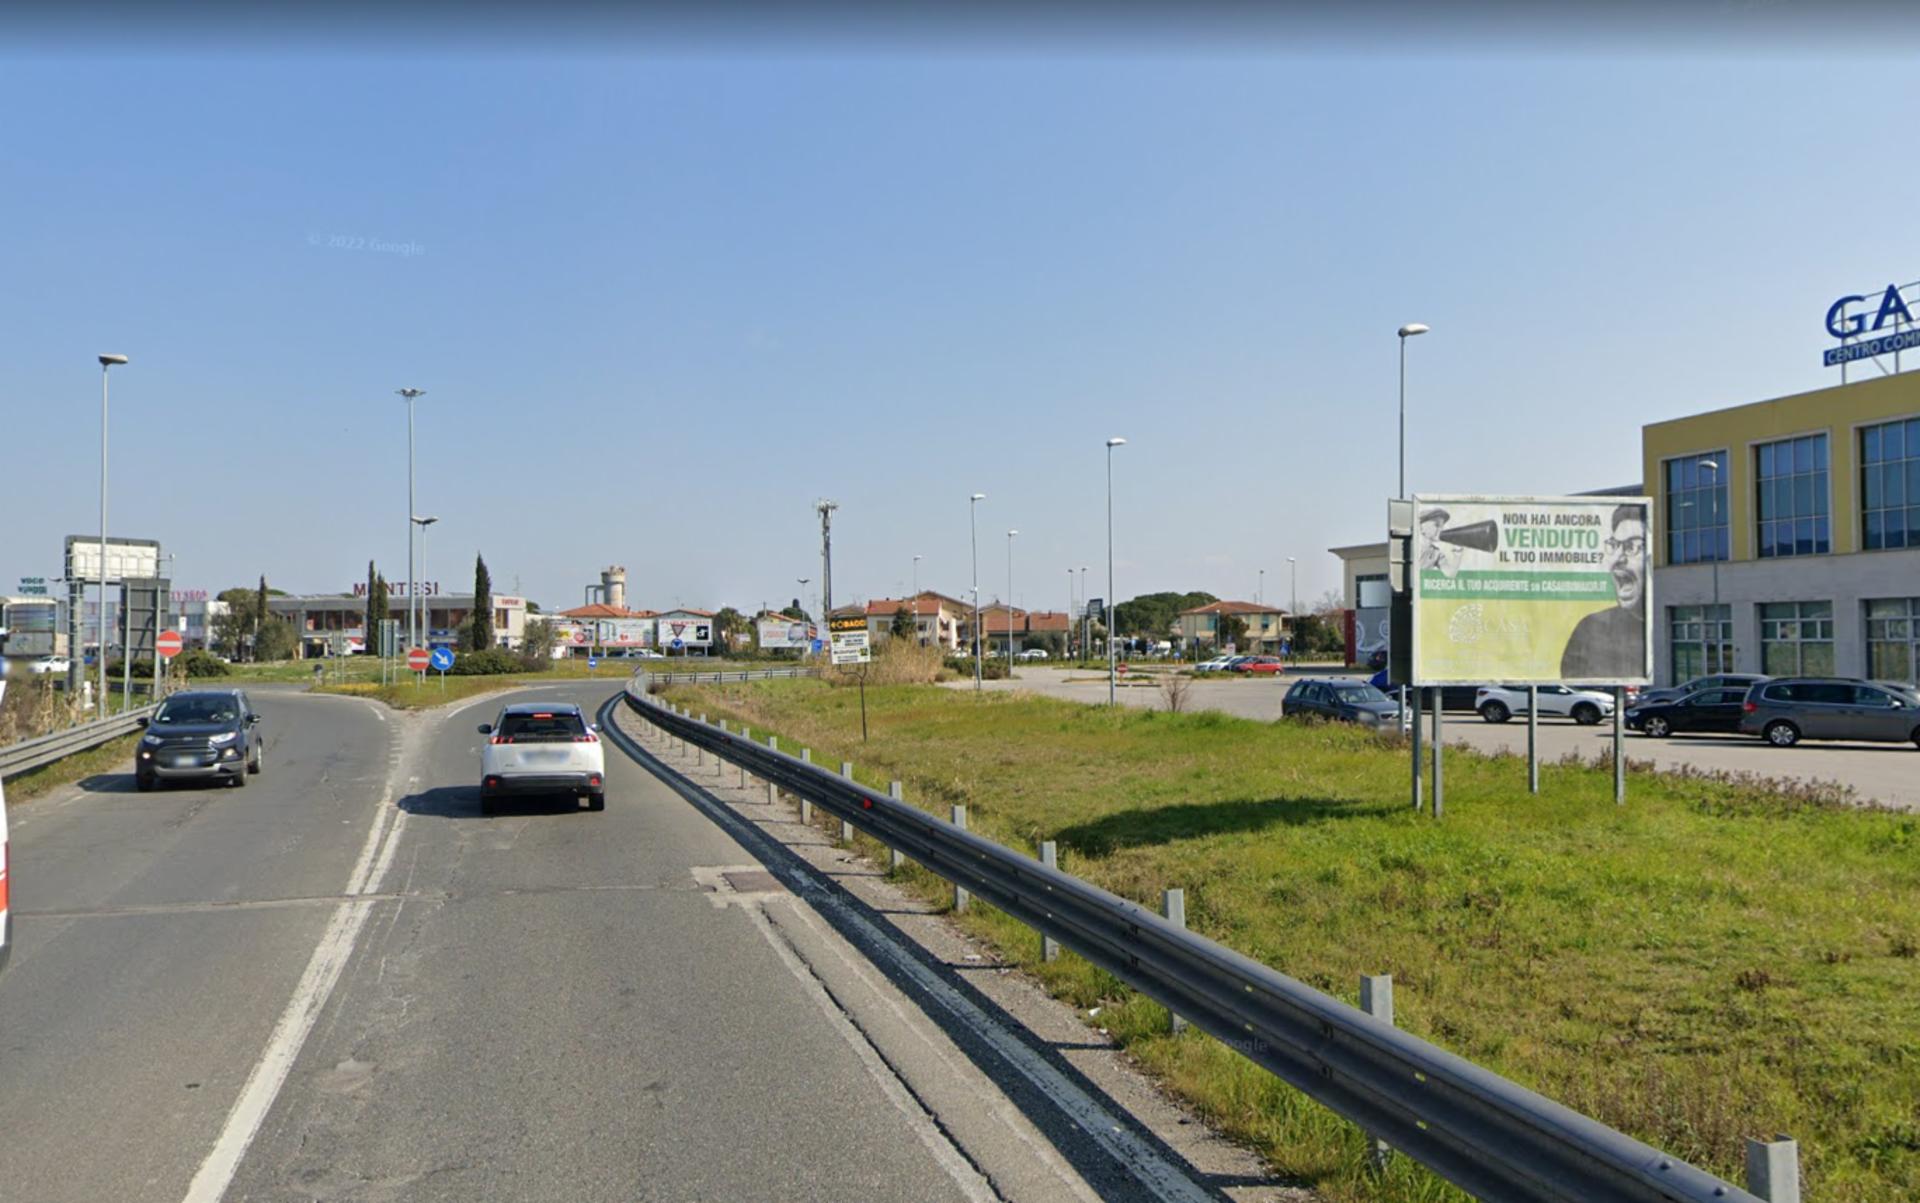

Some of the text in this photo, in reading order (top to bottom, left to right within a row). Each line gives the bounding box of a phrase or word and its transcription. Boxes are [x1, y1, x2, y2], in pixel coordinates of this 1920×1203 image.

[1827, 340, 1881, 364] CENTRO
[1503, 514, 1601, 526] NON HAI ANCORA
[1504, 528, 1600, 549] VENDUTO
[1499, 552, 1604, 564] IL TUO IMMOBILE?
[353, 582, 438, 596] MNTESI
[1424, 578, 1457, 592] RICERCA
[1467, 579, 1482, 592] TUO
